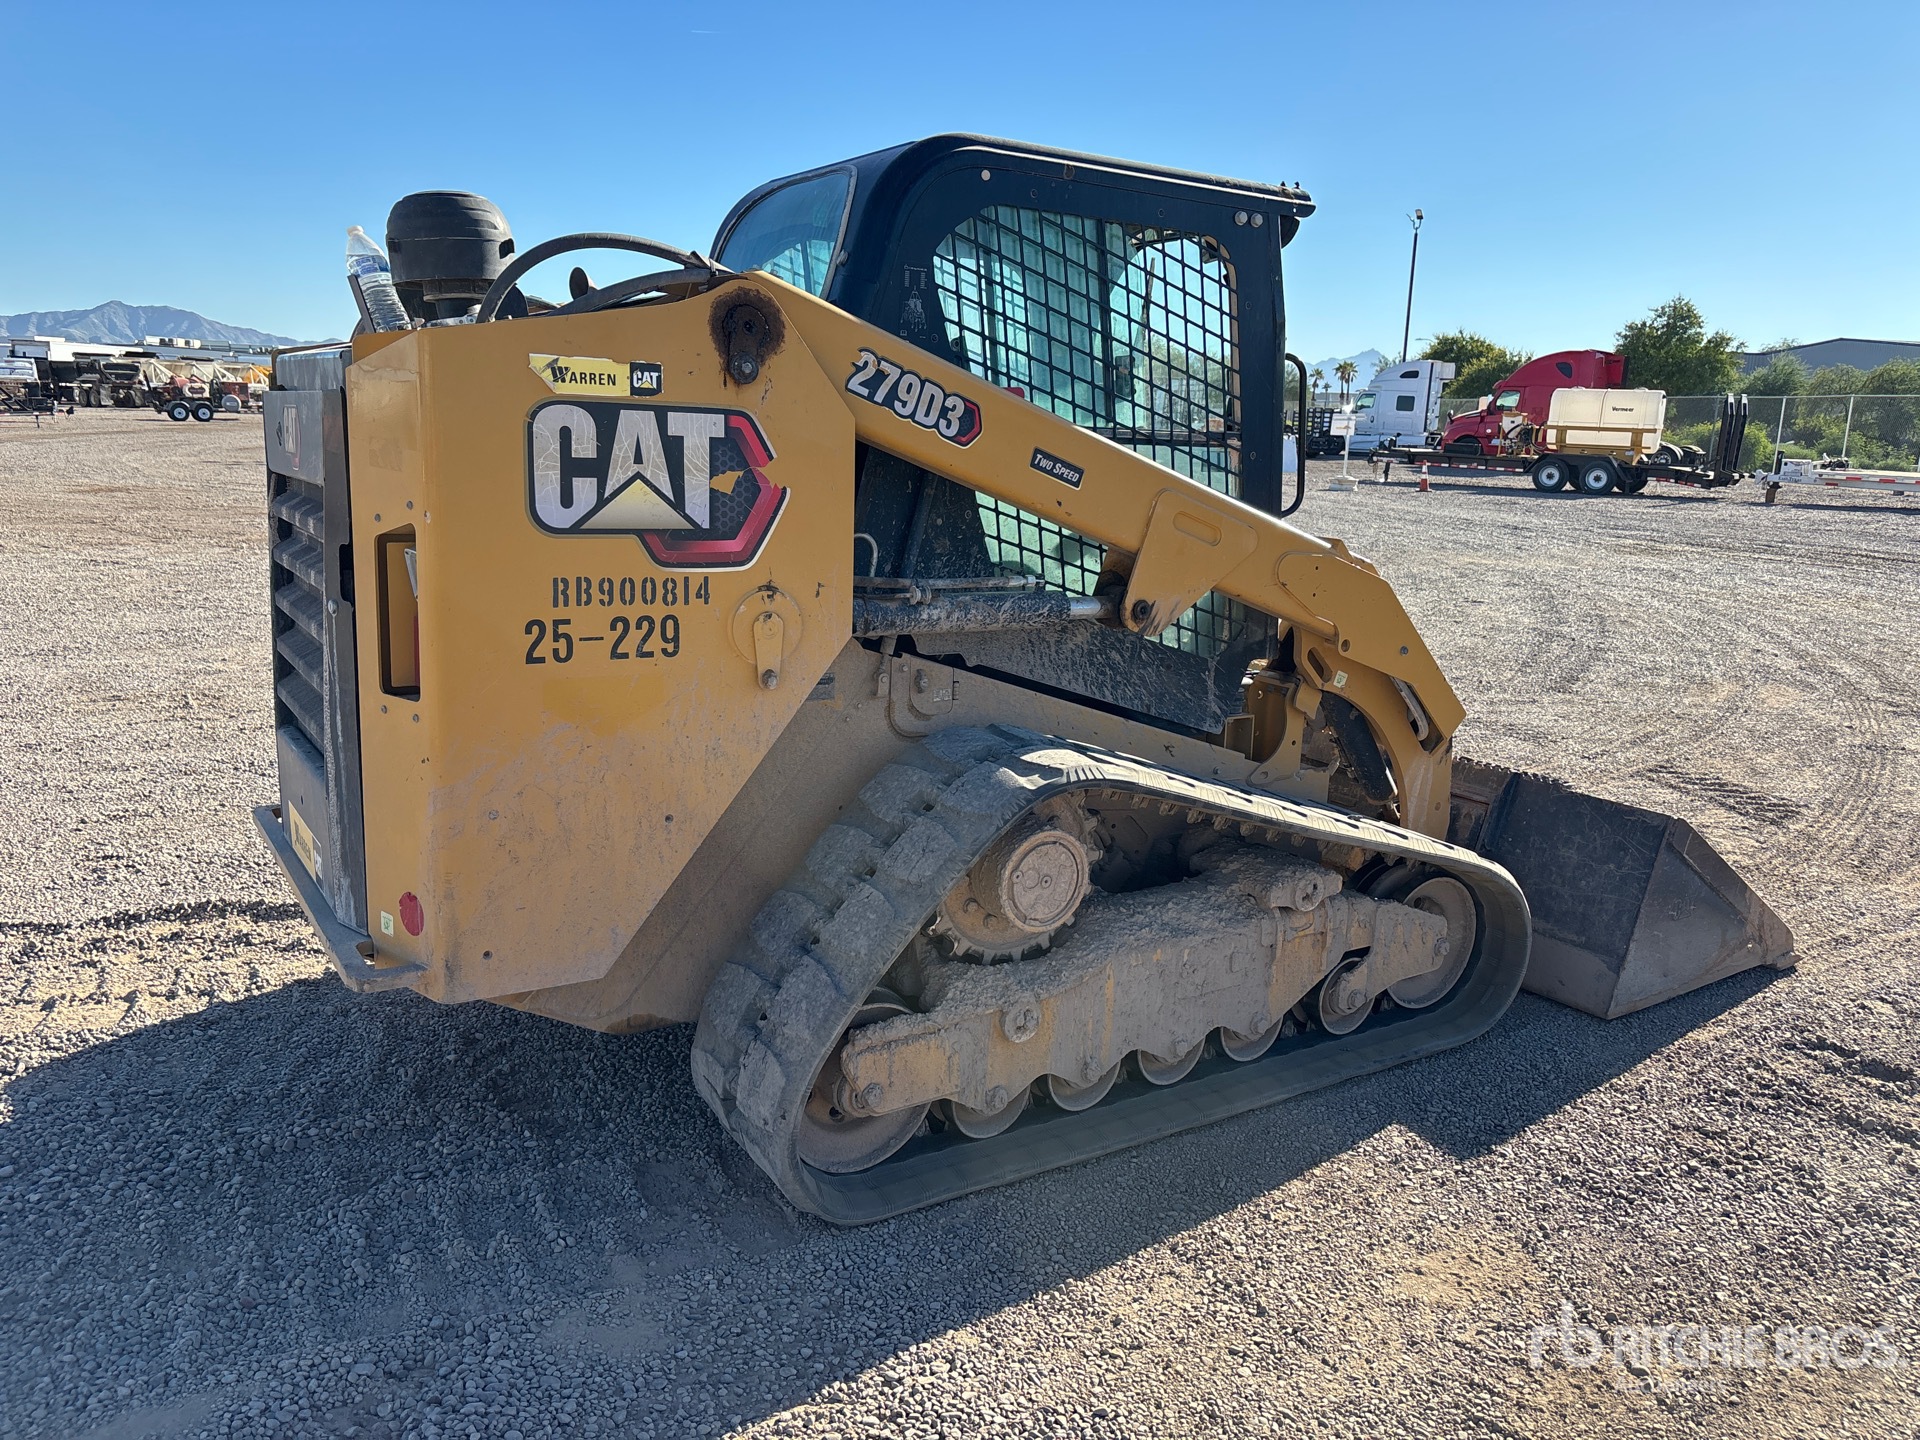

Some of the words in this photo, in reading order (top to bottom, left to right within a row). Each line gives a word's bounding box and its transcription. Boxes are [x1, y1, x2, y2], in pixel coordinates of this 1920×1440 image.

[550, 365, 617, 387] WARREN
[632, 369, 659, 390] CAT
[847, 350, 966, 438] 279D3
[1611, 405, 1635, 413] Vermeer
[532, 403, 725, 530] CAT
[552, 575, 711, 608] RB900814
[524, 614, 681, 665] 25-229
